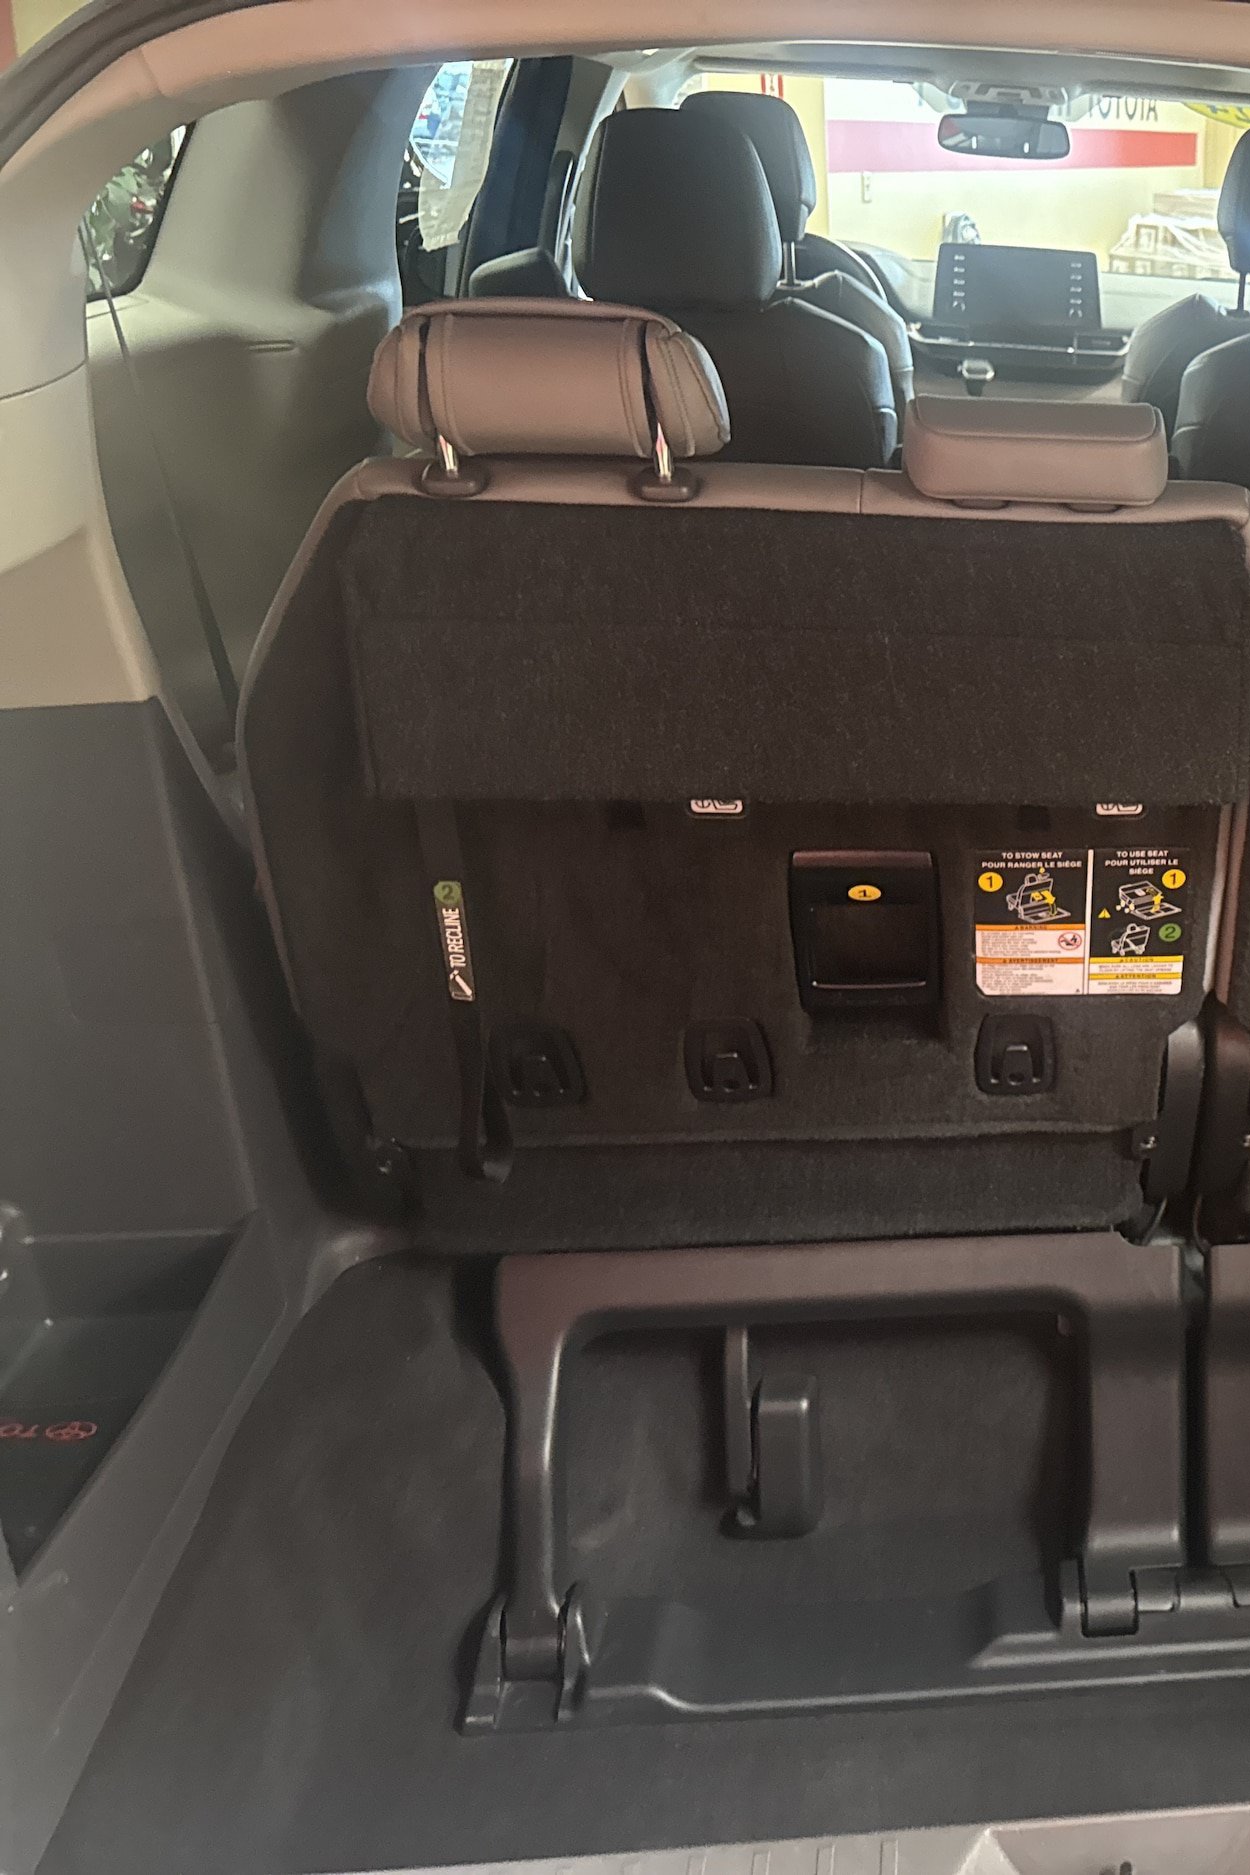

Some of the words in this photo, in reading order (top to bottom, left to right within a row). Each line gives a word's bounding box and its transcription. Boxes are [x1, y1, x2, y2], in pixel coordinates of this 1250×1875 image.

[987, 876, 994, 888] 1
[1170, 874, 1177, 886] 1
[441, 884, 454, 900] 2
[442, 907, 465, 953] RECLINE
[1165, 927, 1175, 939] 2
[449, 954, 467, 969] TO
